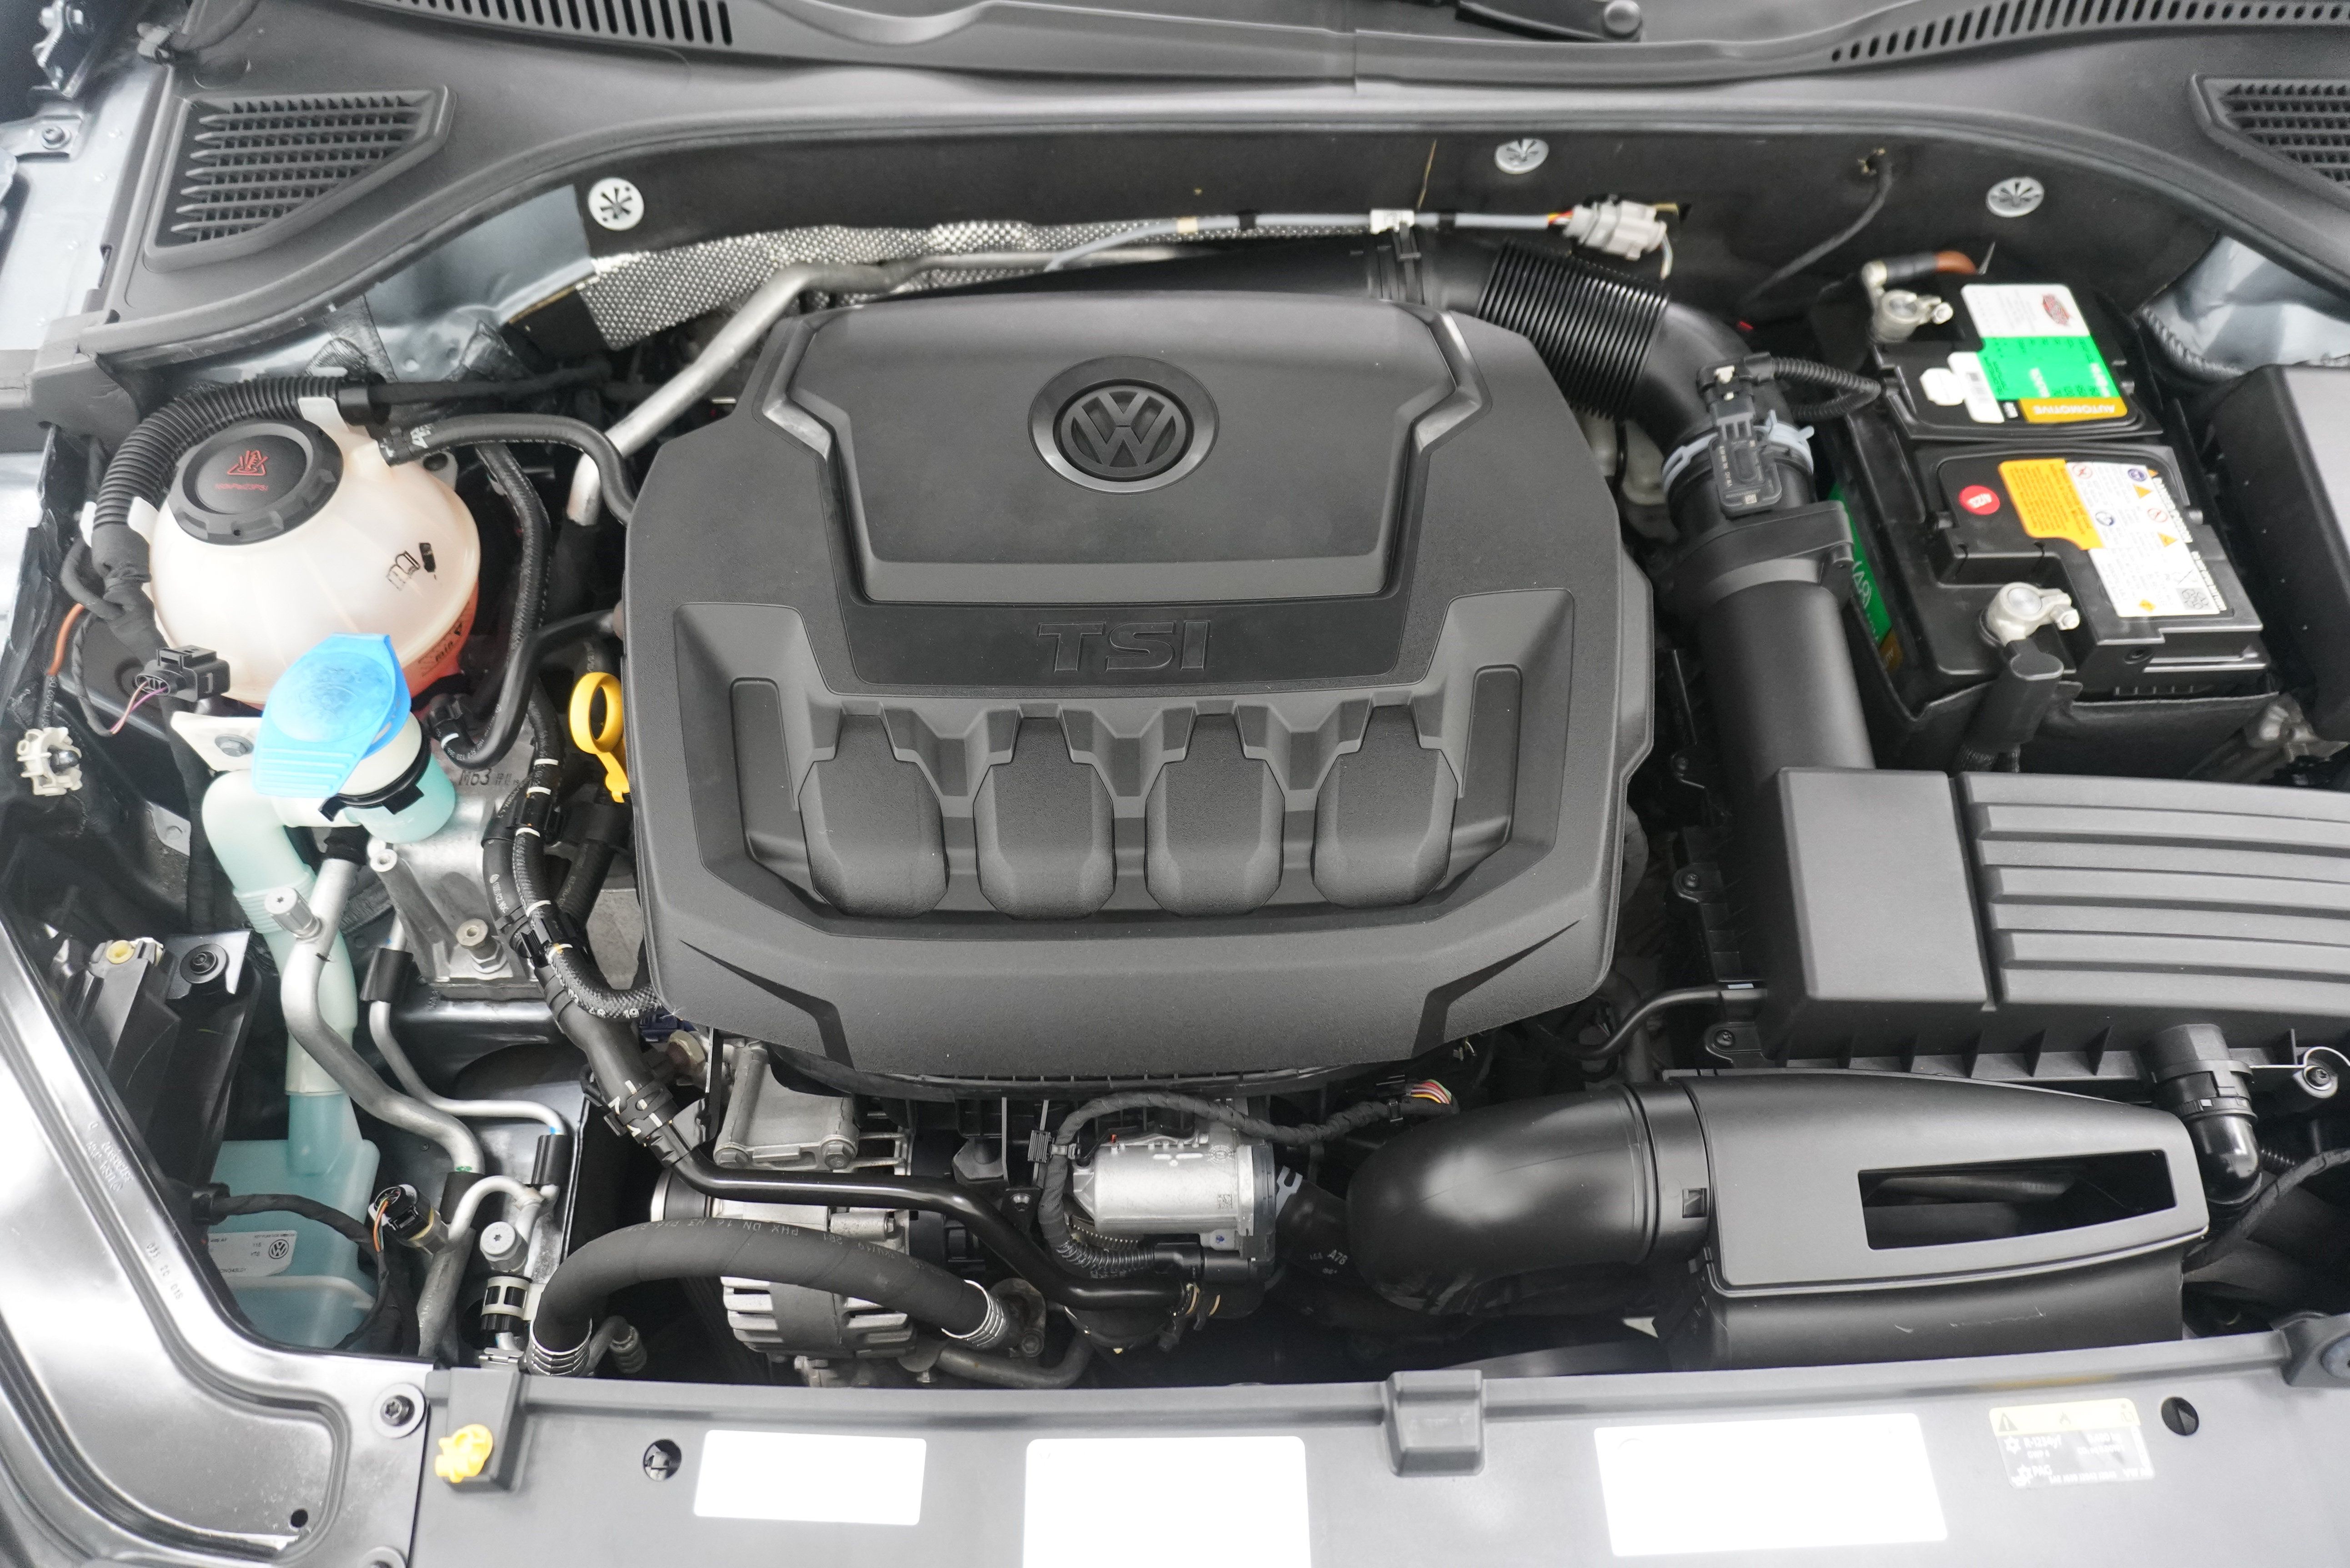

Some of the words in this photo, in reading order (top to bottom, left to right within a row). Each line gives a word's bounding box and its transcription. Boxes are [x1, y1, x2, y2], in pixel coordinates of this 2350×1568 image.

[2032, 404, 2115, 415] AUTOMOTIVE
[1037, 619, 1211, 673] TSI
[743, 1221, 761, 1231] DN
[2032, 1464, 2053, 1477] PAG
